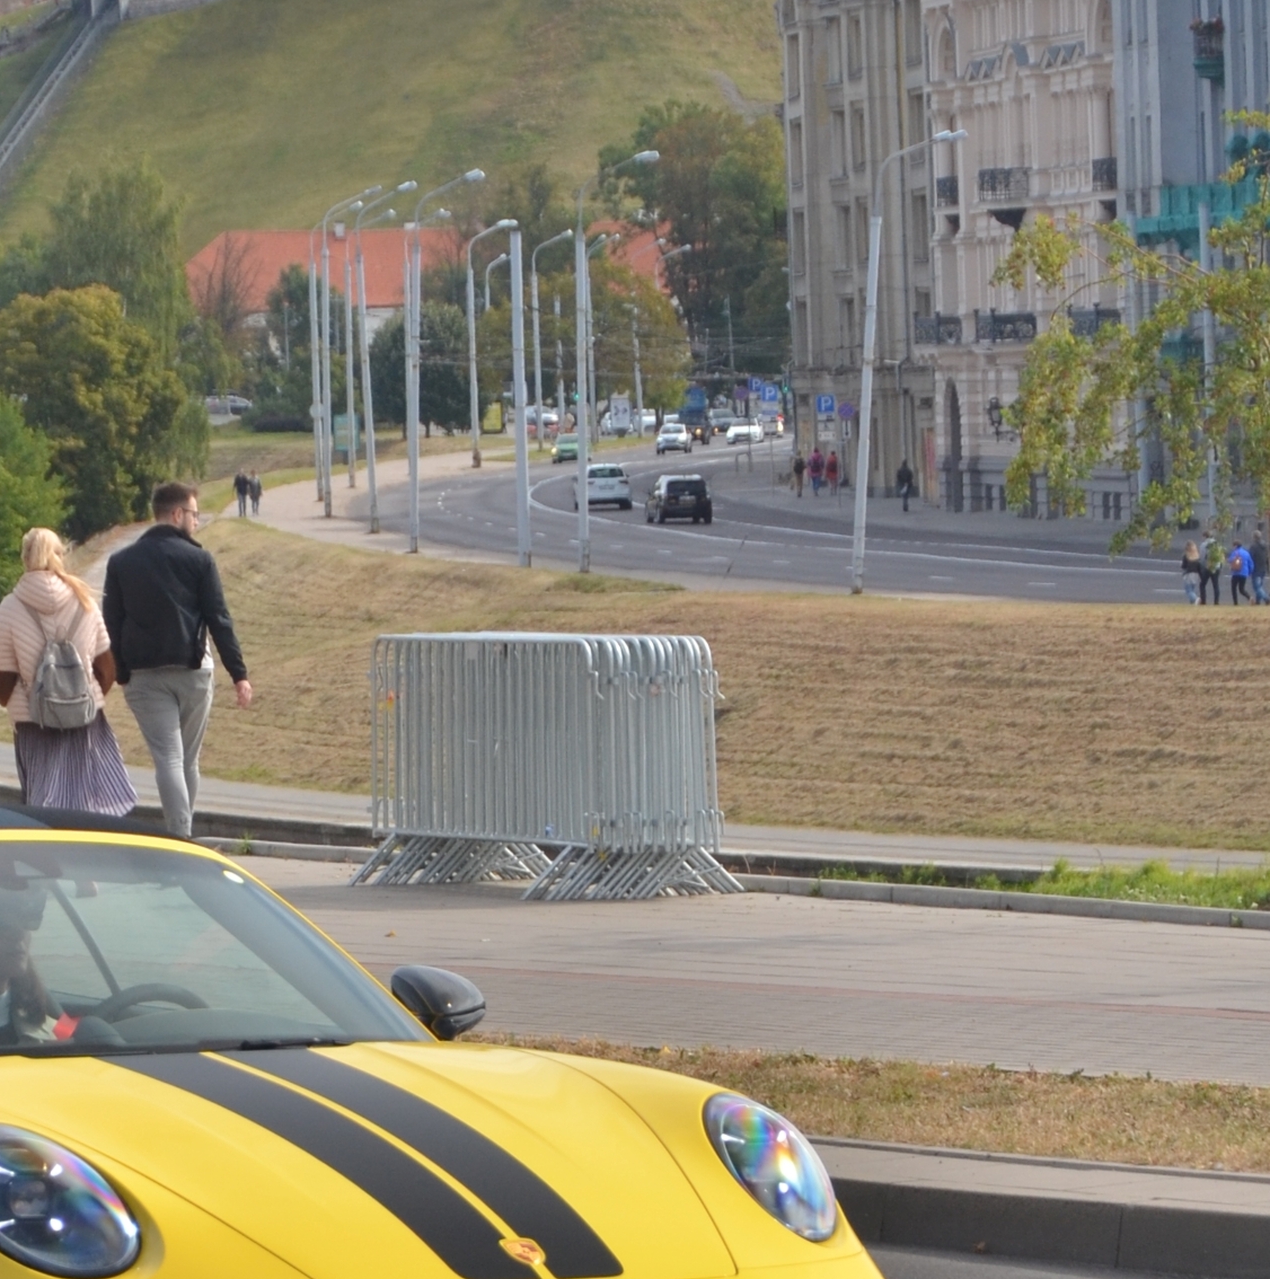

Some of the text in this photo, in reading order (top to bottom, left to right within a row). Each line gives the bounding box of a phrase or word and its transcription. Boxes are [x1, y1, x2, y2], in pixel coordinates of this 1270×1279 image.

[752, 378, 761, 391] P
[765, 386, 776, 401] P
[821, 396, 832, 411] P
